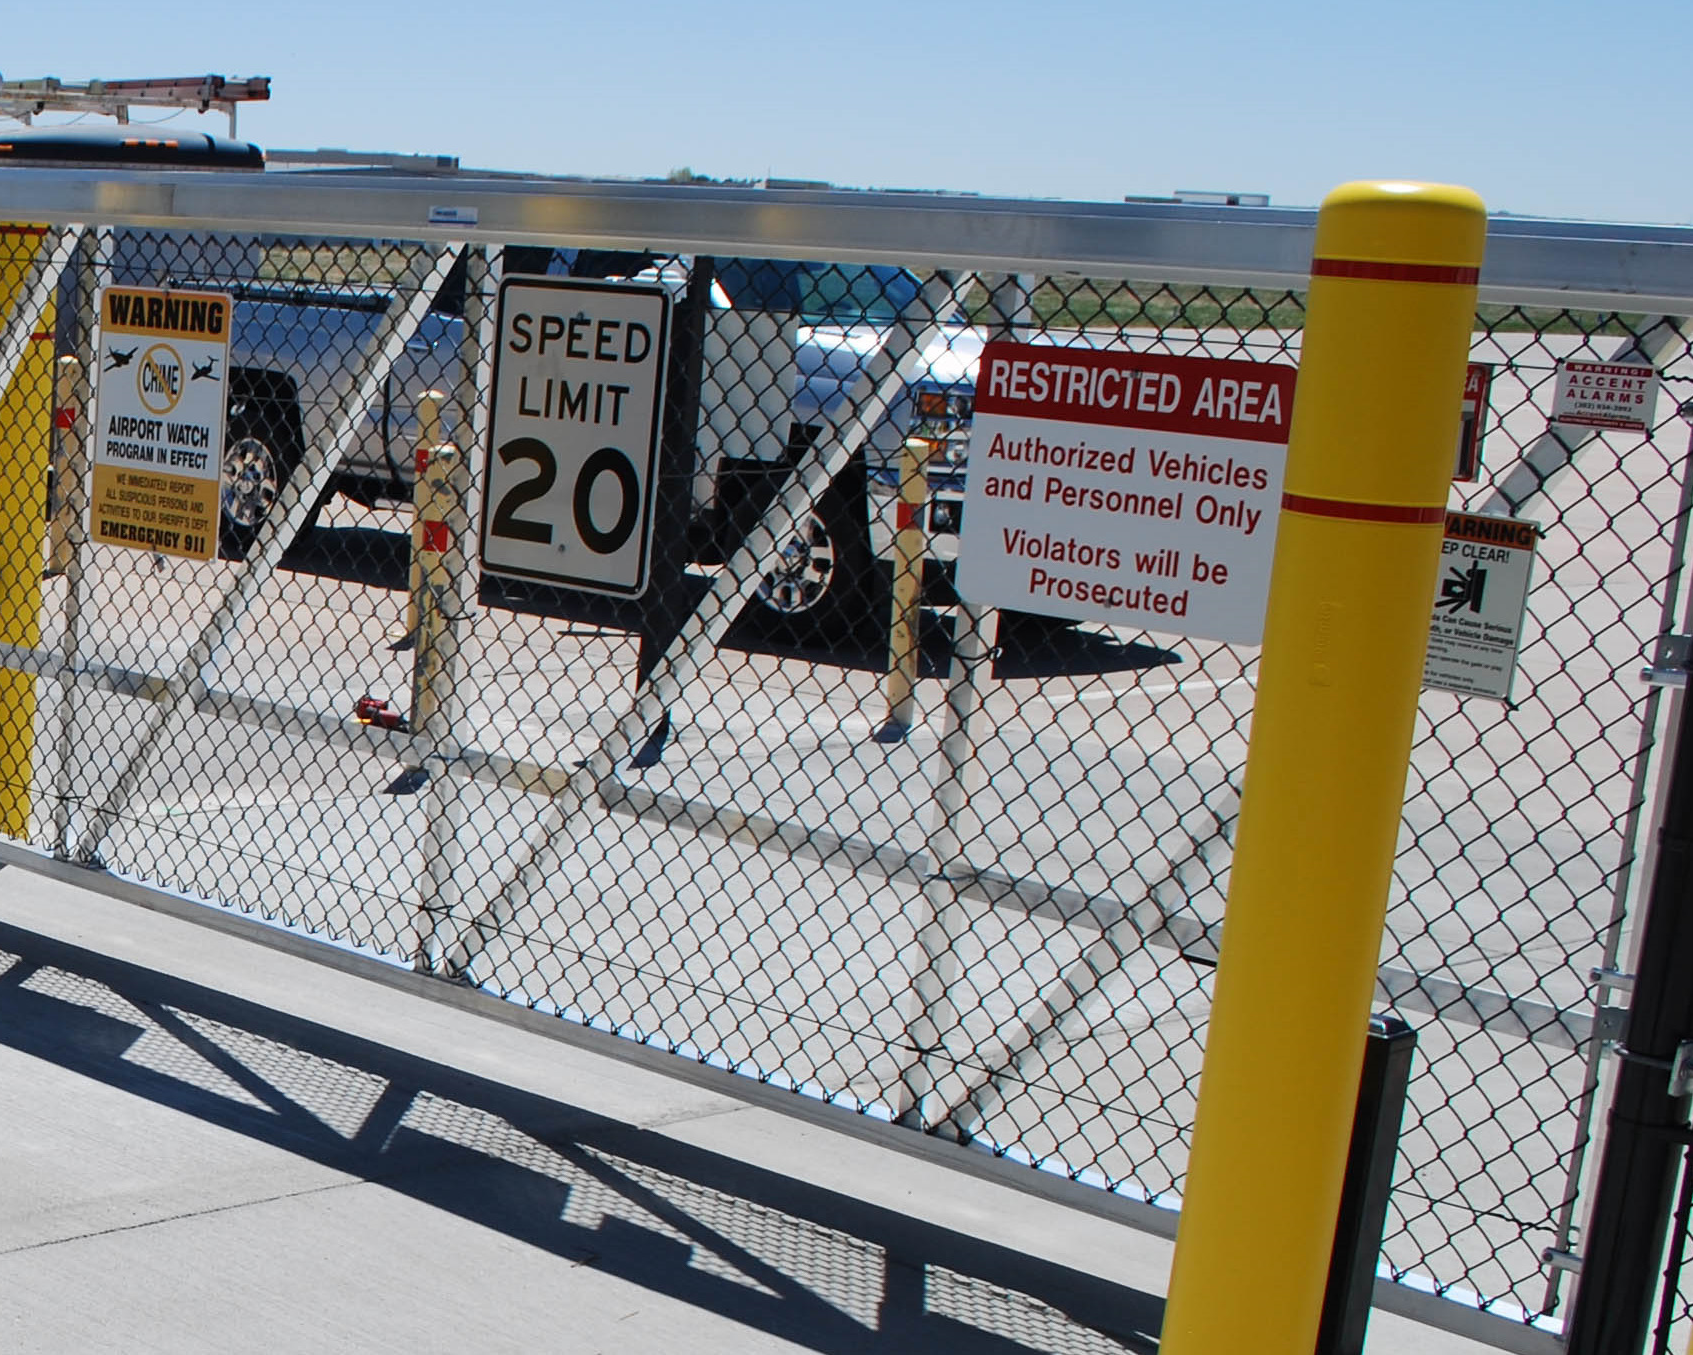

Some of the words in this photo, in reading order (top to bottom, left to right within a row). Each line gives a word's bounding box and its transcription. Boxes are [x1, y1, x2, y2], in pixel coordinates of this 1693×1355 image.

[109, 294, 223, 335] WARNING
[509, 313, 652, 363] SPEED
[142, 362, 179, 396] CRIME
[1569, 374, 1646, 389] ACCENT
[1574, 365, 1645, 375] WARNING!
[519, 376, 630, 426] LIMIT
[988, 359, 1181, 414] RESTRICTED
[1192, 377, 1282, 425] AREA
[1566, 389, 1644, 404] ALARMS
[108, 415, 163, 441] AIRPORT
[167, 422, 209, 448] WATCH
[106, 441, 154, 462] PROGRAM
[157, 448, 167, 464] IN
[170, 449, 208, 470] EFFECT
[988, 432, 1135, 474] Authorized
[1149, 449, 1268, 490] Vehicles
[106, 487, 117, 499] ALL
[119, 489, 157, 506] SUSPICIOUS
[158, 495, 187, 511] PERSONS
[190, 501, 204, 513] AND
[116, 472, 126, 485] WE
[129, 474, 168, 491] IMMEDIATELY
[169, 480, 195, 495] REPORT
[490, 437, 640, 555] 20
[98, 503, 131, 519] ACTIVITIES
[132, 508, 141, 520] TO
[143, 510, 157, 522] OUR
[985, 475, 1033, 500] and
[1045, 477, 1183, 519] Personnel
[1196, 495, 1262, 535] Only
[100, 521, 180, 548] EMERGENCY
[184, 534, 205, 553] 911
[1442, 541, 1458, 554] EP
[1462, 544, 1509, 563] CLEAR!
[1003, 528, 1121, 569] Violators
[1135, 549, 1179, 578] will
[1192, 554, 1228, 585] be
[1029, 568, 1188, 617] Prosecuted
[1442, 615, 1456, 623] Can
[1459, 618, 1481, 628] Cause
[1484, 623, 1512, 634] Serious
